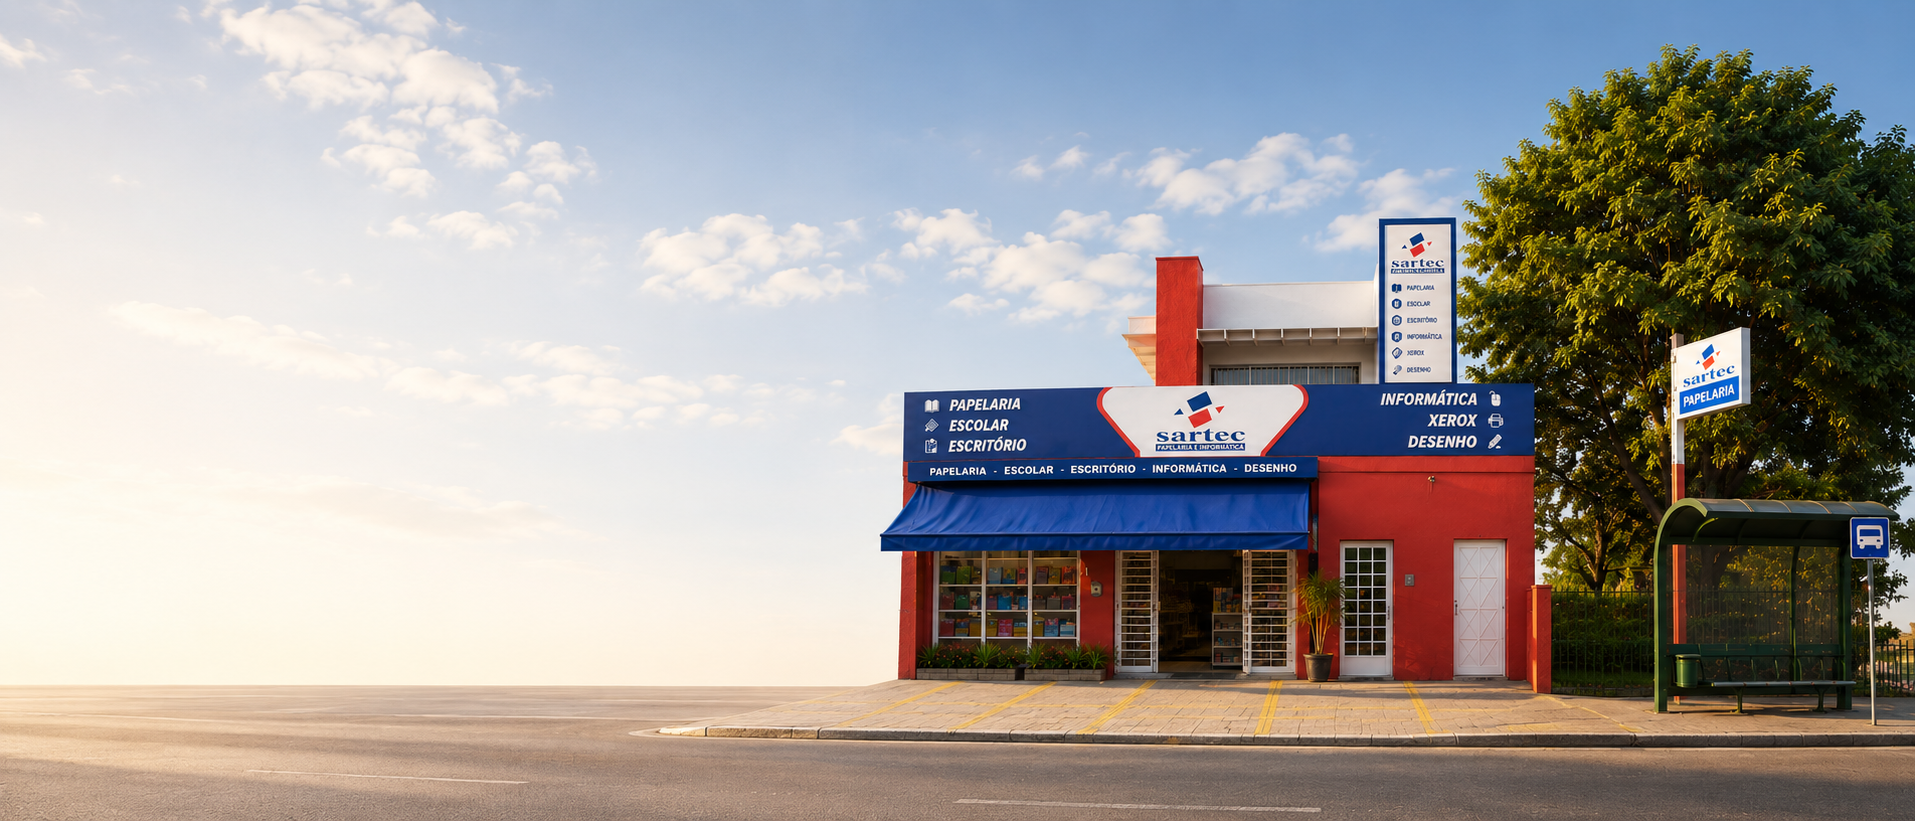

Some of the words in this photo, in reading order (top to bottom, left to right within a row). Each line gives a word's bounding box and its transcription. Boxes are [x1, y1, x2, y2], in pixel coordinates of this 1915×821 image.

[1391, 258, 1444, 268] sartec
[1683, 365, 1735, 388] sartec
[1380, 388, 1478, 406] INFORMÁTICA
[1683, 383, 1735, 408] PAPELARIA
[949, 398, 1021, 412] PAPELARIA
[949, 419, 1009, 432] ESCOLAR
[1427, 413, 1478, 427] XEROX
[1156, 428, 1246, 442] sartec
[1407, 435, 1478, 449] DESENHO
[948, 436, 1027, 453] ESCRITÓRIO
[929, 466, 987, 476] PAPELARIA
[1004, 465, 1054, 475] ESCOLAR
[1070, 463, 1136, 474] ESCRITÓRIO
[1152, 462, 1227, 473] INFORMÁTICA
[1244, 463, 1297, 473] DESENHO
